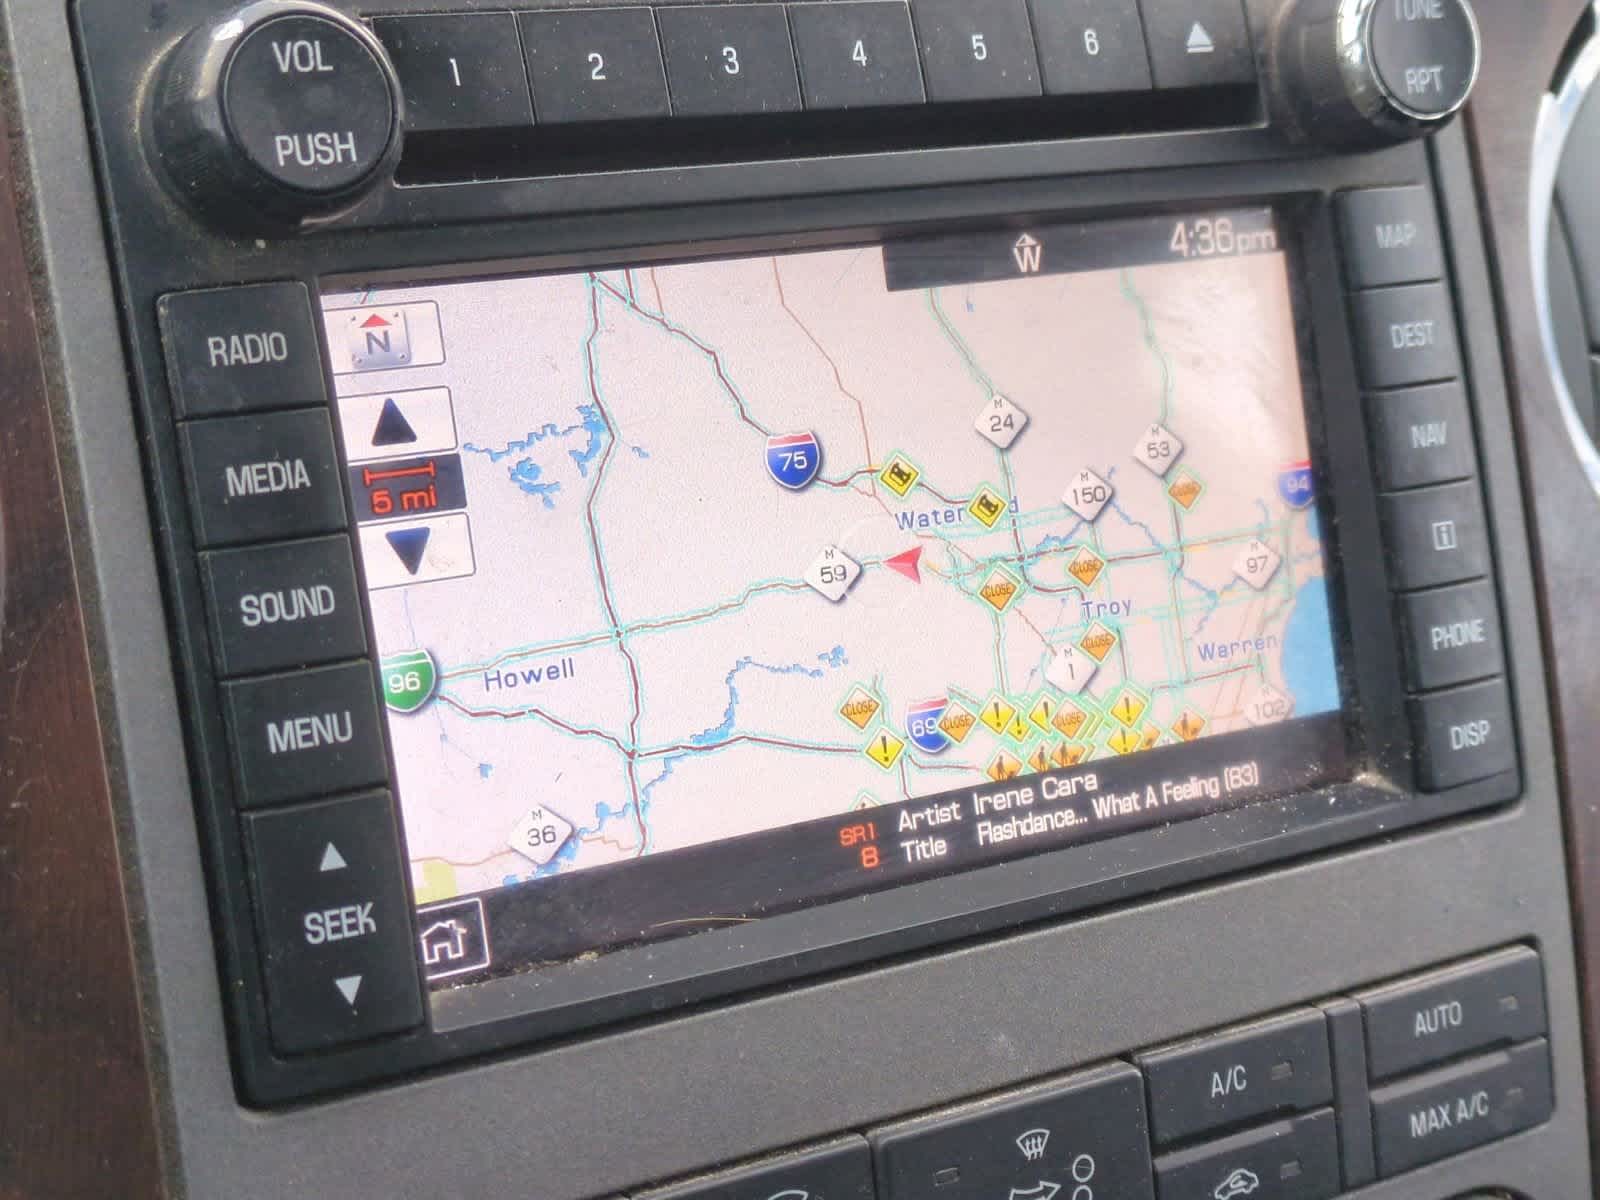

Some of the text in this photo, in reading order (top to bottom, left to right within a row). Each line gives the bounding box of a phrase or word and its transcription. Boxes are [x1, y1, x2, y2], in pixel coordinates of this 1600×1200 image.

[1393, 0, 1443, 20] TUNE
[851, 39, 868, 68] 4
[971, 33, 988, 61] 5
[1084, 28, 1101, 56] 6
[272, 40, 334, 74] VOL
[588, 52, 607, 81] 2
[722, 46, 740, 75] 3
[449, 57, 462, 87] 1
[1404, 65, 1445, 96] RPT
[274, 131, 358, 168] PUSH
[1375, 222, 1418, 250] MAP
[1013, 245, 1042, 273] W
[366, 328, 391, 355] N
[1391, 319, 1436, 350] DEST
[207, 331, 288, 368] RADIO
[994, 398, 1003, 408] M
[988, 412, 1016, 433] 24
[1411, 421, 1447, 449] NAV
[777, 450, 809, 473] 75
[225, 458, 312, 498] MEDIA
[1079, 471, 1089, 482] M
[401, 484, 438, 512] mi
[1071, 485, 1108, 506] 150
[824, 549, 835, 560] M
[1245, 554, 1269, 575] 97
[819, 563, 848, 585] 59
[239, 585, 336, 628] SOUND
[1081, 598, 1132, 621] Troy
[1197, 635, 1279, 662] Warren
[1431, 618, 1487, 651] PHONE
[387, 671, 422, 694] 96
[483, 657, 576, 693] Howell
[267, 711, 354, 755] MENU
[1450, 720, 1491, 751] DISP
[531, 808, 543, 821] M
[898, 772, 1098, 833] Artist Irene Cara
[901, 836, 948, 863] Title
[1092, 790, 1142, 819] What
[1146, 785, 1159, 809] A
[1162, 775, 1220, 806] Feeling
[526, 824, 558, 848] 36
[304, 901, 378, 946] SEEK
[1414, 1001, 1464, 1037] AUTO
[1211, 1064, 1248, 1099] A/C
[1410, 1091, 1490, 1139] MAX A/C
